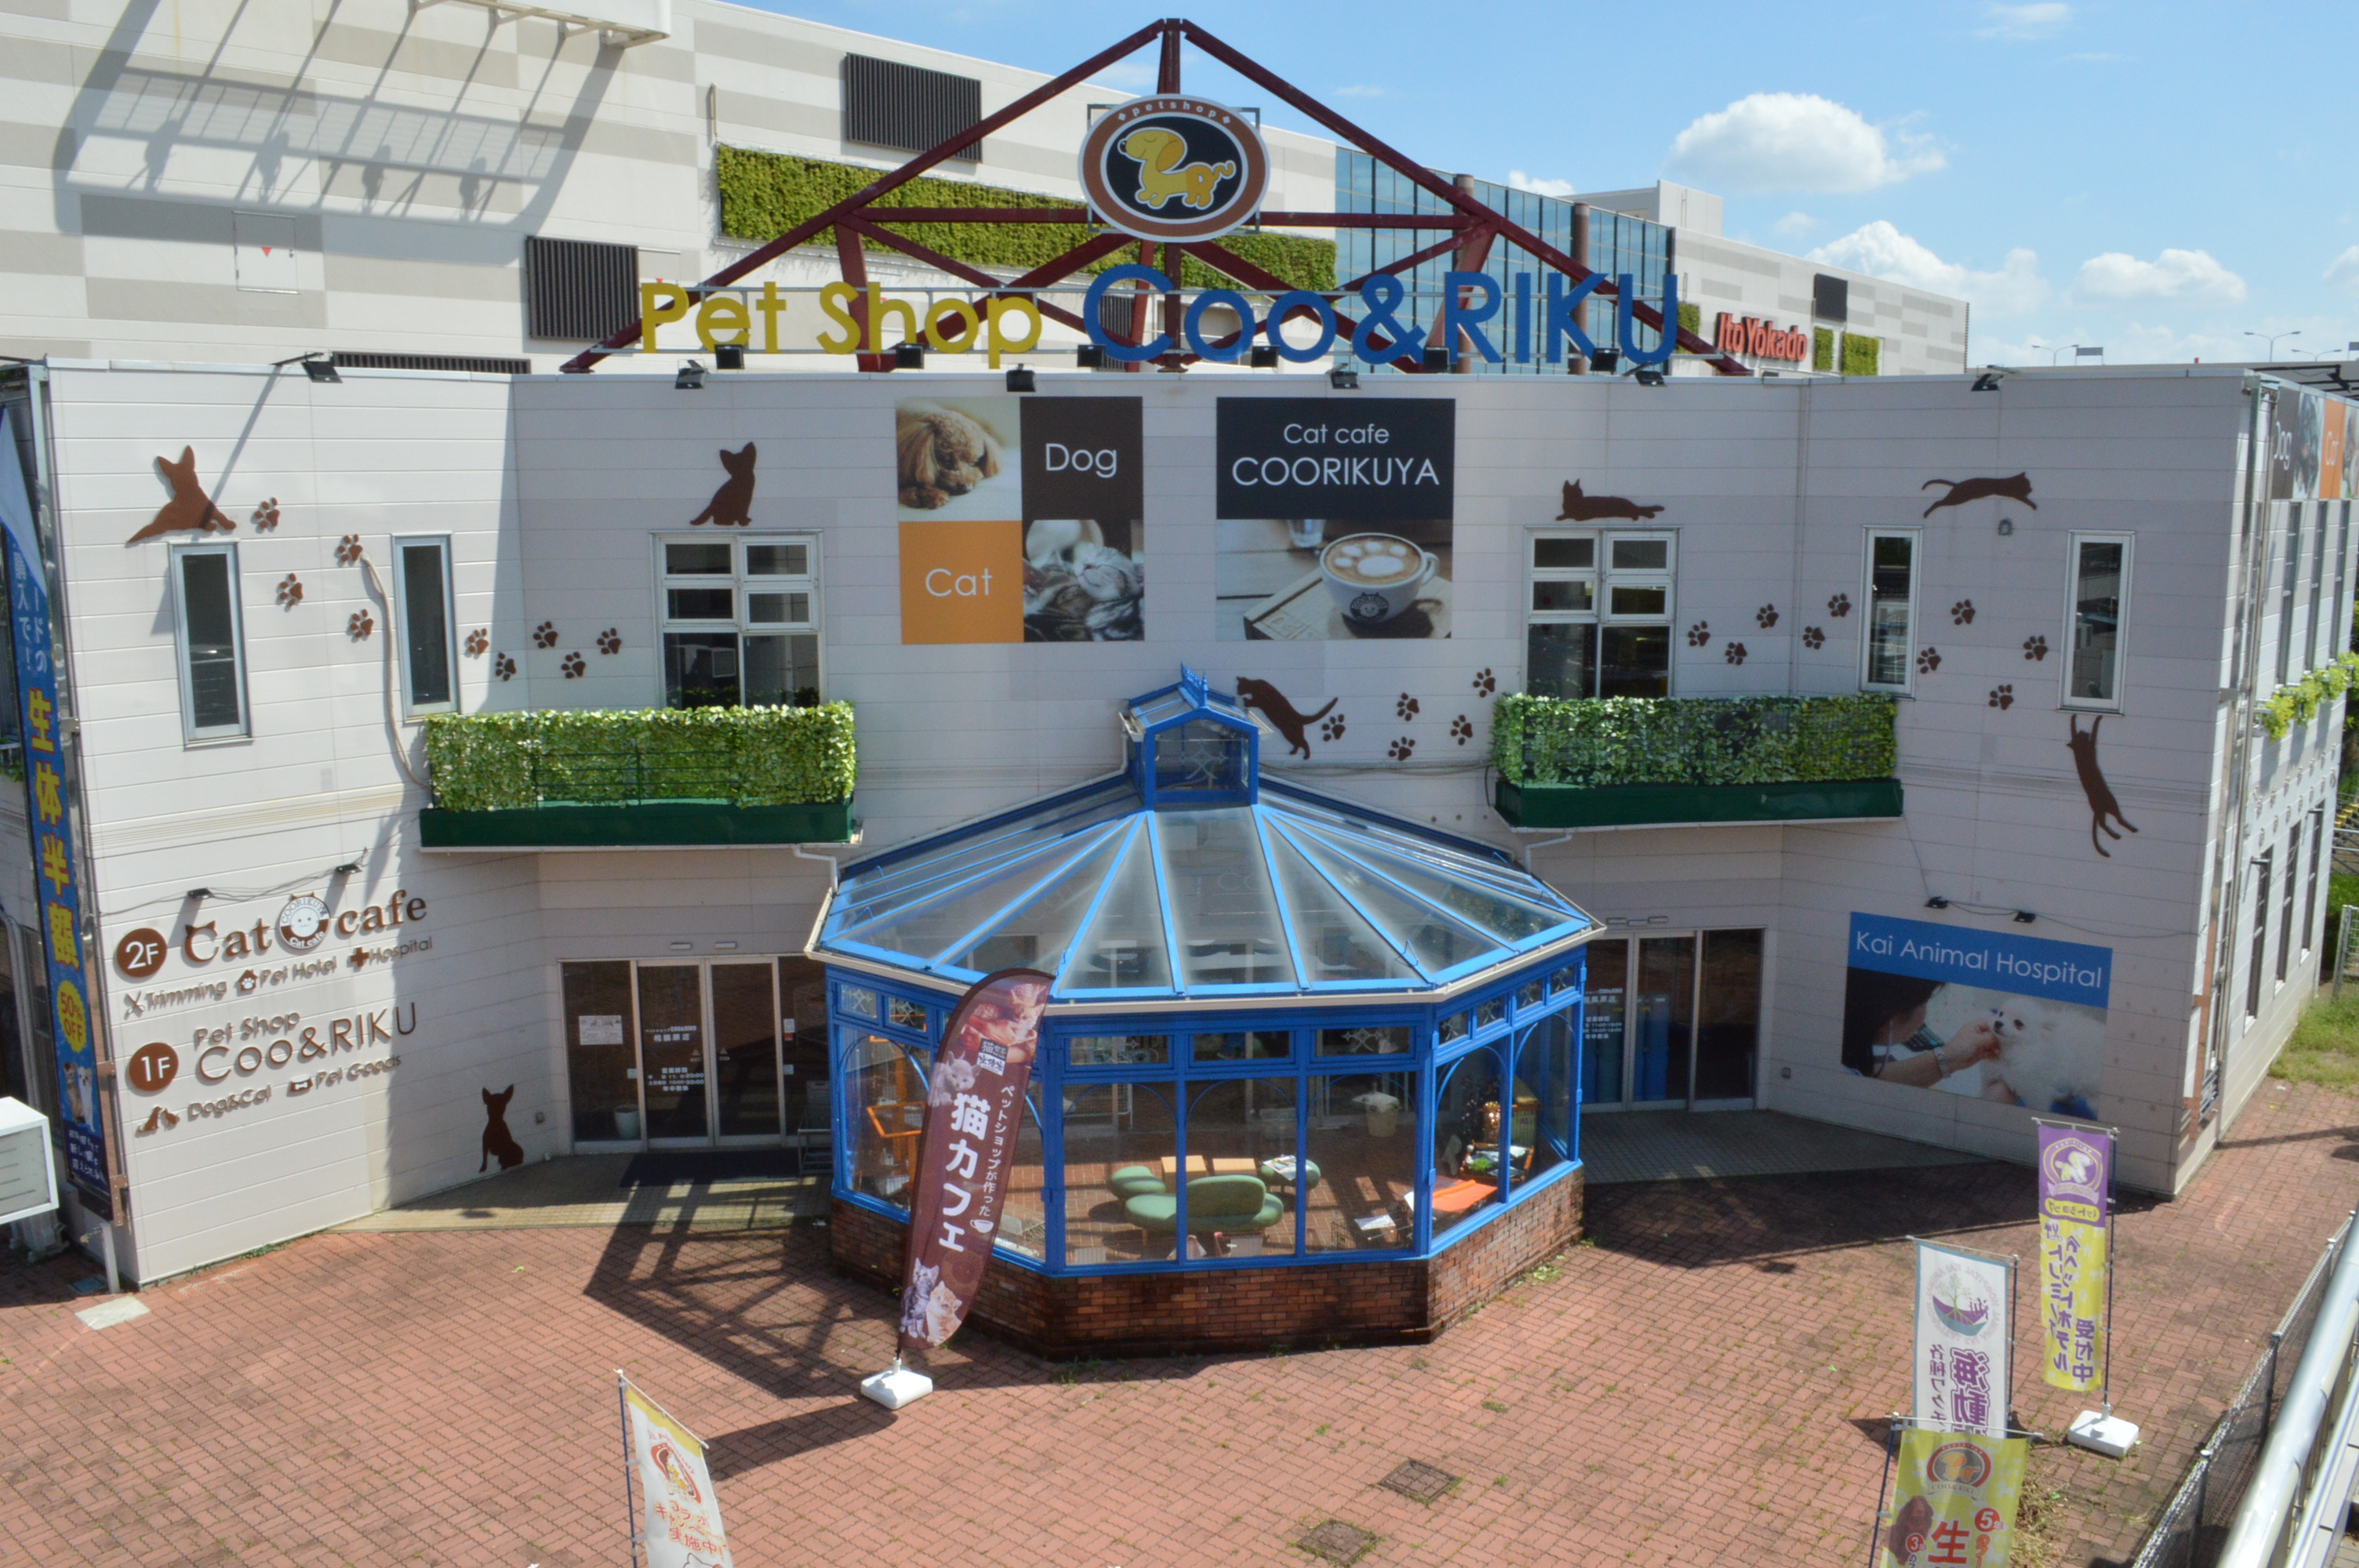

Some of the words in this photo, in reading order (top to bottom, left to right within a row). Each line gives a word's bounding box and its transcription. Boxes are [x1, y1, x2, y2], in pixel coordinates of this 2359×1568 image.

[1132, 100, 1217, 118] petshop
[641, 281, 787, 353] Pet
[816, 281, 1042, 369] Shop
[1283, 423, 1329, 445] Cat
[1334, 423, 1390, 445] cafe
[1045, 443, 1118, 478] Dog
[1231, 456, 1440, 487] COORIKUYA
[925, 568, 993, 597] Cat
[27, 687, 80, 971] 生体半額
[184, 918, 273, 962] Cat
[338, 889, 427, 935] cafe
[289, 936, 306, 948] Cat
[125, 941, 159, 970] 2F
[146, 981, 227, 1008] Trimming
[261, 966, 288, 982] Pet
[294, 956, 336, 977] Hotel
[370, 937, 433, 963] Hospital
[1856, 931, 1893, 956] Kai
[1900, 939, 1988, 971] Animal
[1996, 952, 2102, 988] Hospital
[195, 1022, 234, 1045] Pet
[241, 1011, 300, 1039] Shop
[141, 1055, 171, 1082] 1F
[189, 1085, 272, 1119] Dog&Cat
[316, 1067, 343, 1087] Pet
[347, 1054, 402, 1080] Goods
[979, 1085, 1016, 1217] ペットショップが作った
[939, 1092, 991, 1253] 猫カフェ
